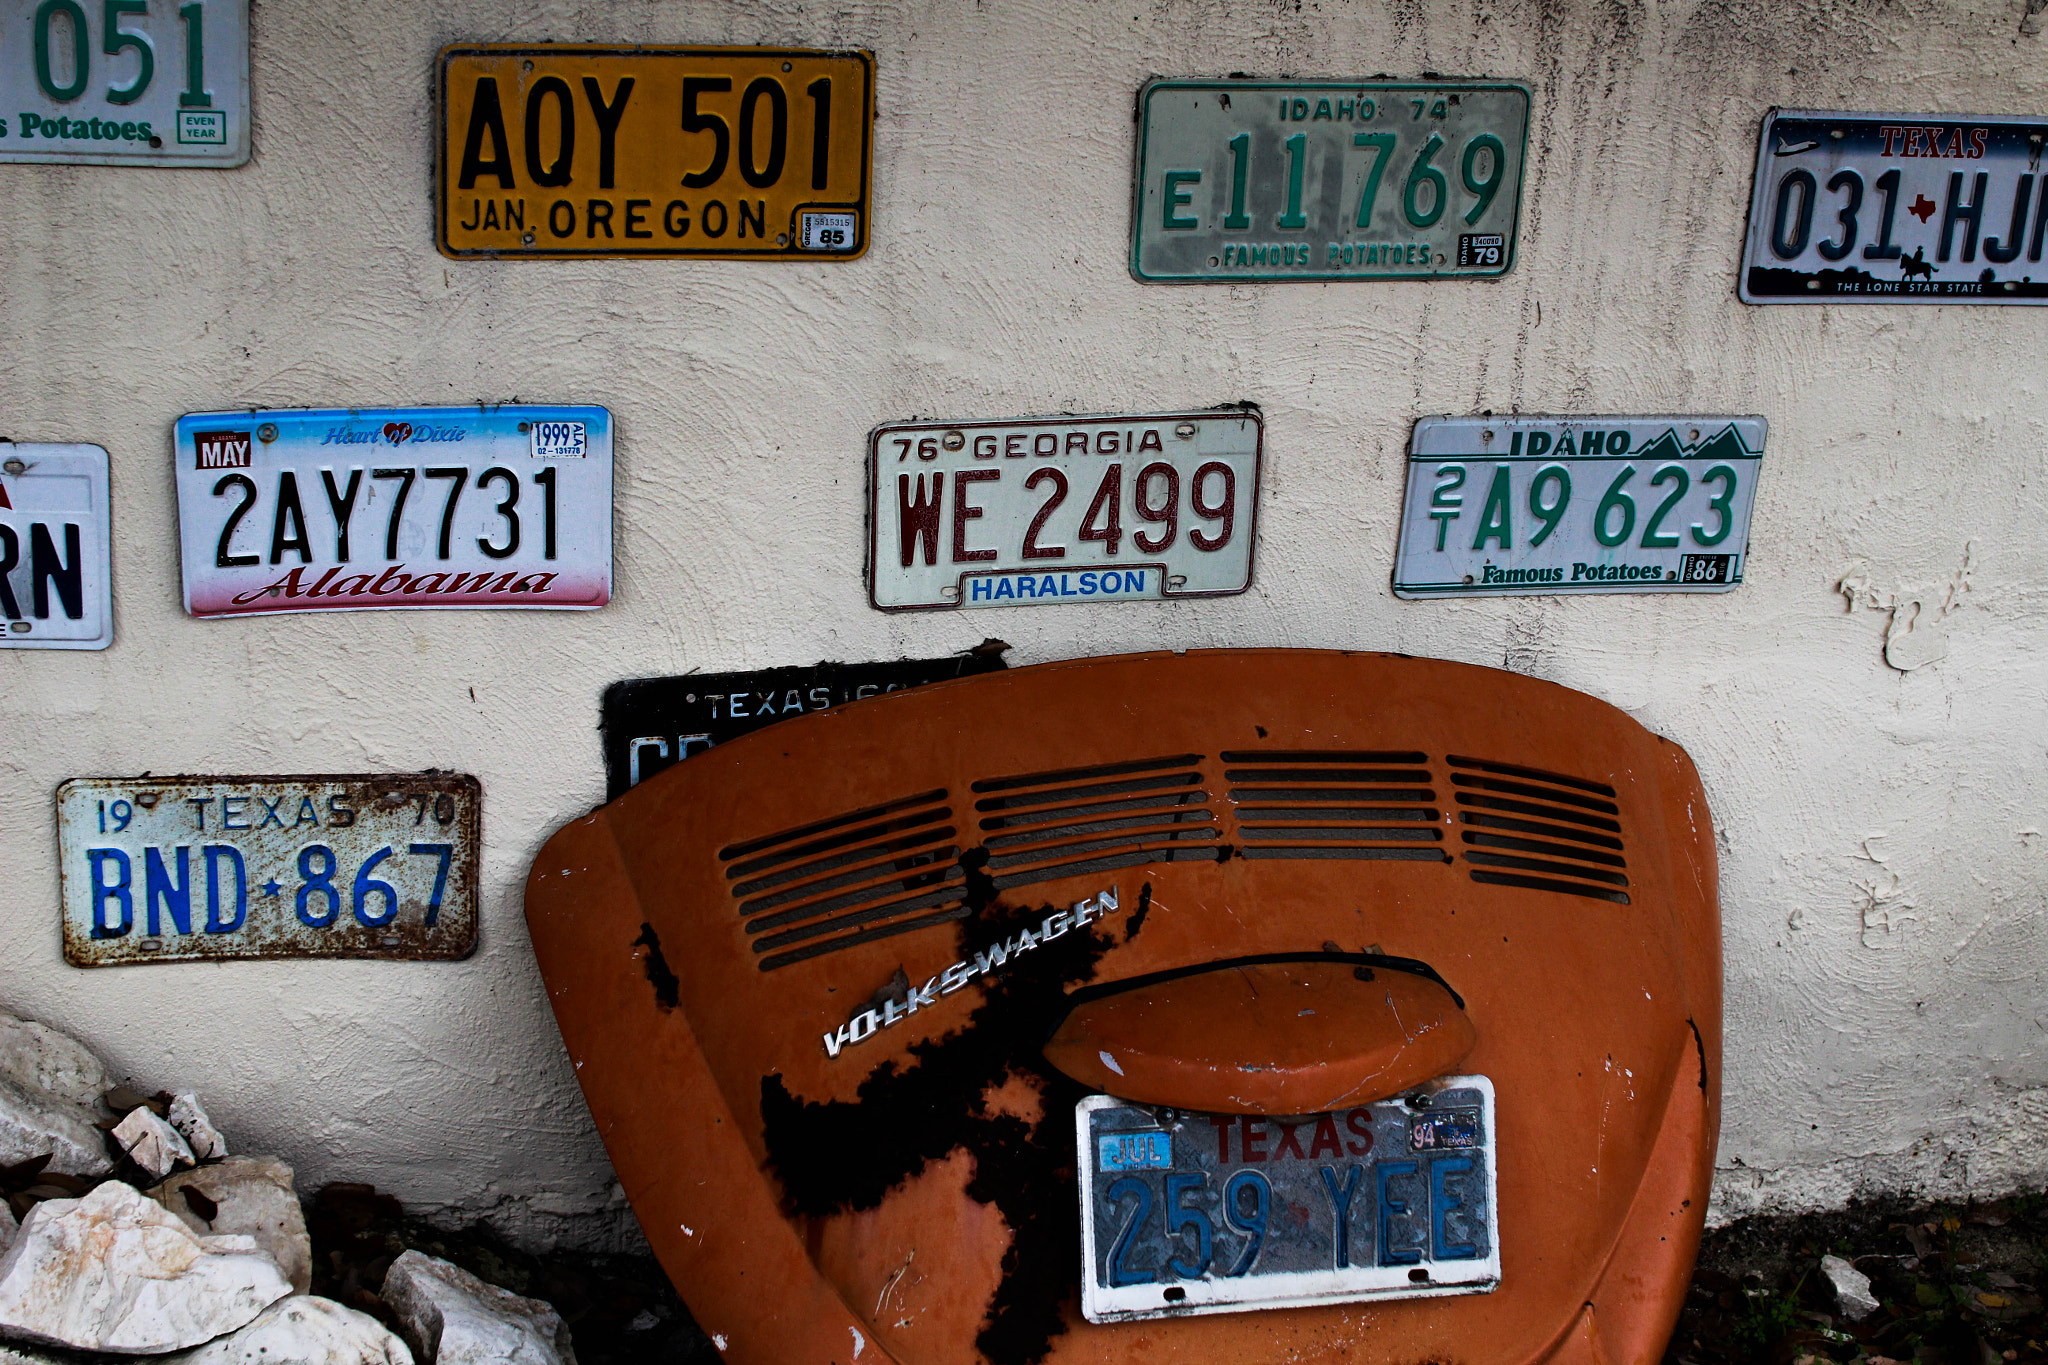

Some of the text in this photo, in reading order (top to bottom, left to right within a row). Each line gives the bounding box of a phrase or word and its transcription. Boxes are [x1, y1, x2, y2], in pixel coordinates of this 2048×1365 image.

[35, 0, 211, 106] 051
[186, 117, 215, 126] EVEN
[1280, 98, 1448, 121] IDAHO 74
[19, 113, 152, 141] Potatoes
[186, 129, 215, 138] YEAR
[458, 76, 832, 191] AQY 501
[1879, 126, 1988, 160] TEXAS
[549, 199, 766, 239] OREGON
[1771, 169, 1902, 261] 031
[804, 216, 812, 246] OREGON
[820, 229, 845, 245] 85
[1222, 242, 1431, 266] FAMOUS POTATOES
[1460, 236, 1469, 265] IDAHO
[1474, 247, 1499, 264] 79
[1837, 282, 1983, 293] THE LONE STAR STATE
[320, 424, 468, 448] Heart of Dixie
[535, 423, 570, 447] 1999
[573, 424, 584, 447] ALA
[894, 430, 1164, 461] 76 GEORGIA
[1509, 429, 1632, 456] IDAHO
[202, 440, 249, 467] MAY
[212, 465, 558, 568] 2AY7731
[1481, 562, 1663, 584] Famous Potatoes
[1685, 556, 1695, 581] IDAHO
[1692, 560, 1718, 581] 86
[230, 564, 560, 606] Alabama
[971, 571, 1146, 602] HARALSON
[704, 686, 831, 720] TEXAS
[98, 793, 455, 833] 19 TEXAS 70
[87, 843, 453, 940] BND 867
[823, 884, 1120, 1060] VOLKSWAGEN
[1208, 1107, 1375, 1164] TEXAS
[1414, 1123, 1436, 1149] 94
[1112, 1137, 1162, 1164] JUL
[1106, 1157, 1478, 1288] 259 YEE
